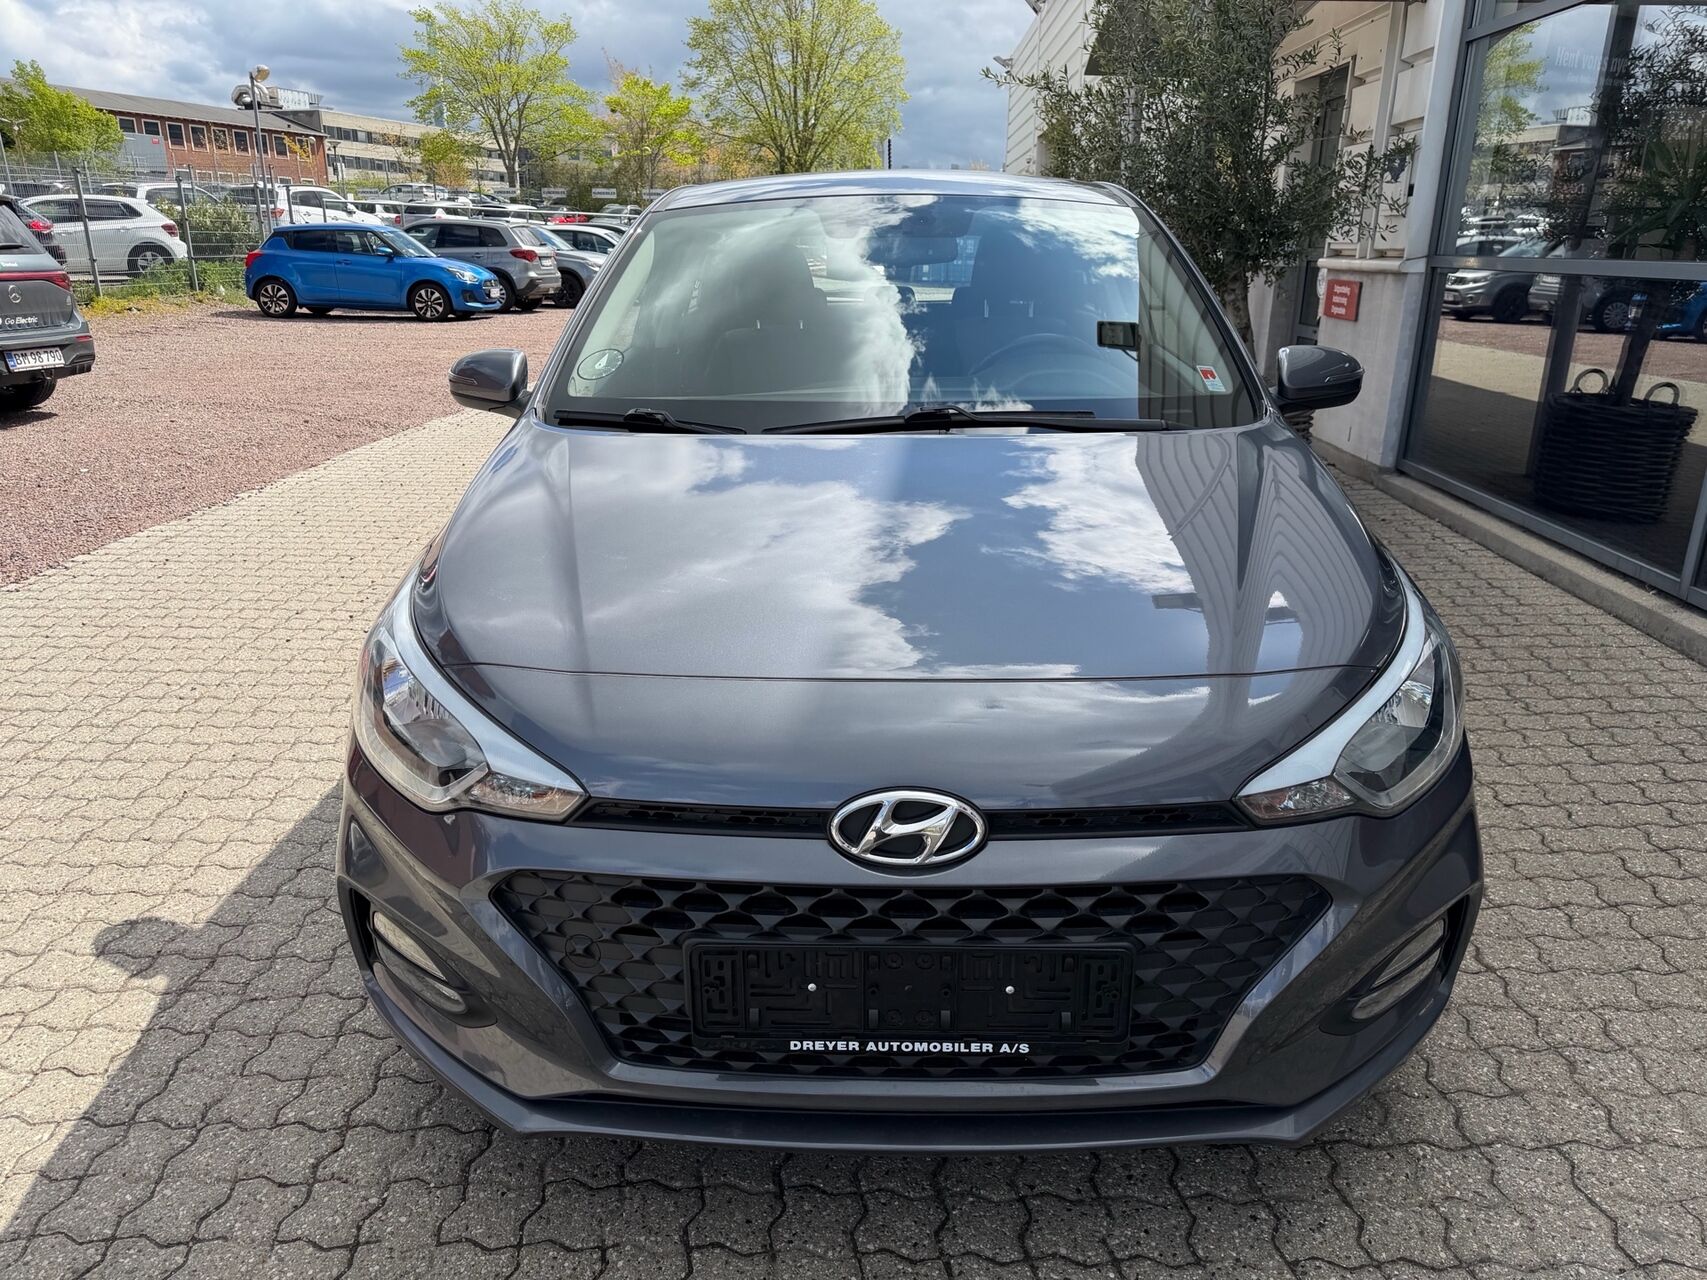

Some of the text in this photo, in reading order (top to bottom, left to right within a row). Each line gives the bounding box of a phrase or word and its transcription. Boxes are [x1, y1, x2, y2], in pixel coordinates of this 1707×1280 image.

[1582, 54, 1609, 72] vors
[4, 315, 38, 325] Go Electric
[13, 353, 31, 366] BM
[30, 351, 44, 364] 98
[43, 349, 62, 363] 790
[789, 1040, 1030, 1054] DREYER AUTOMOBILER A/S
